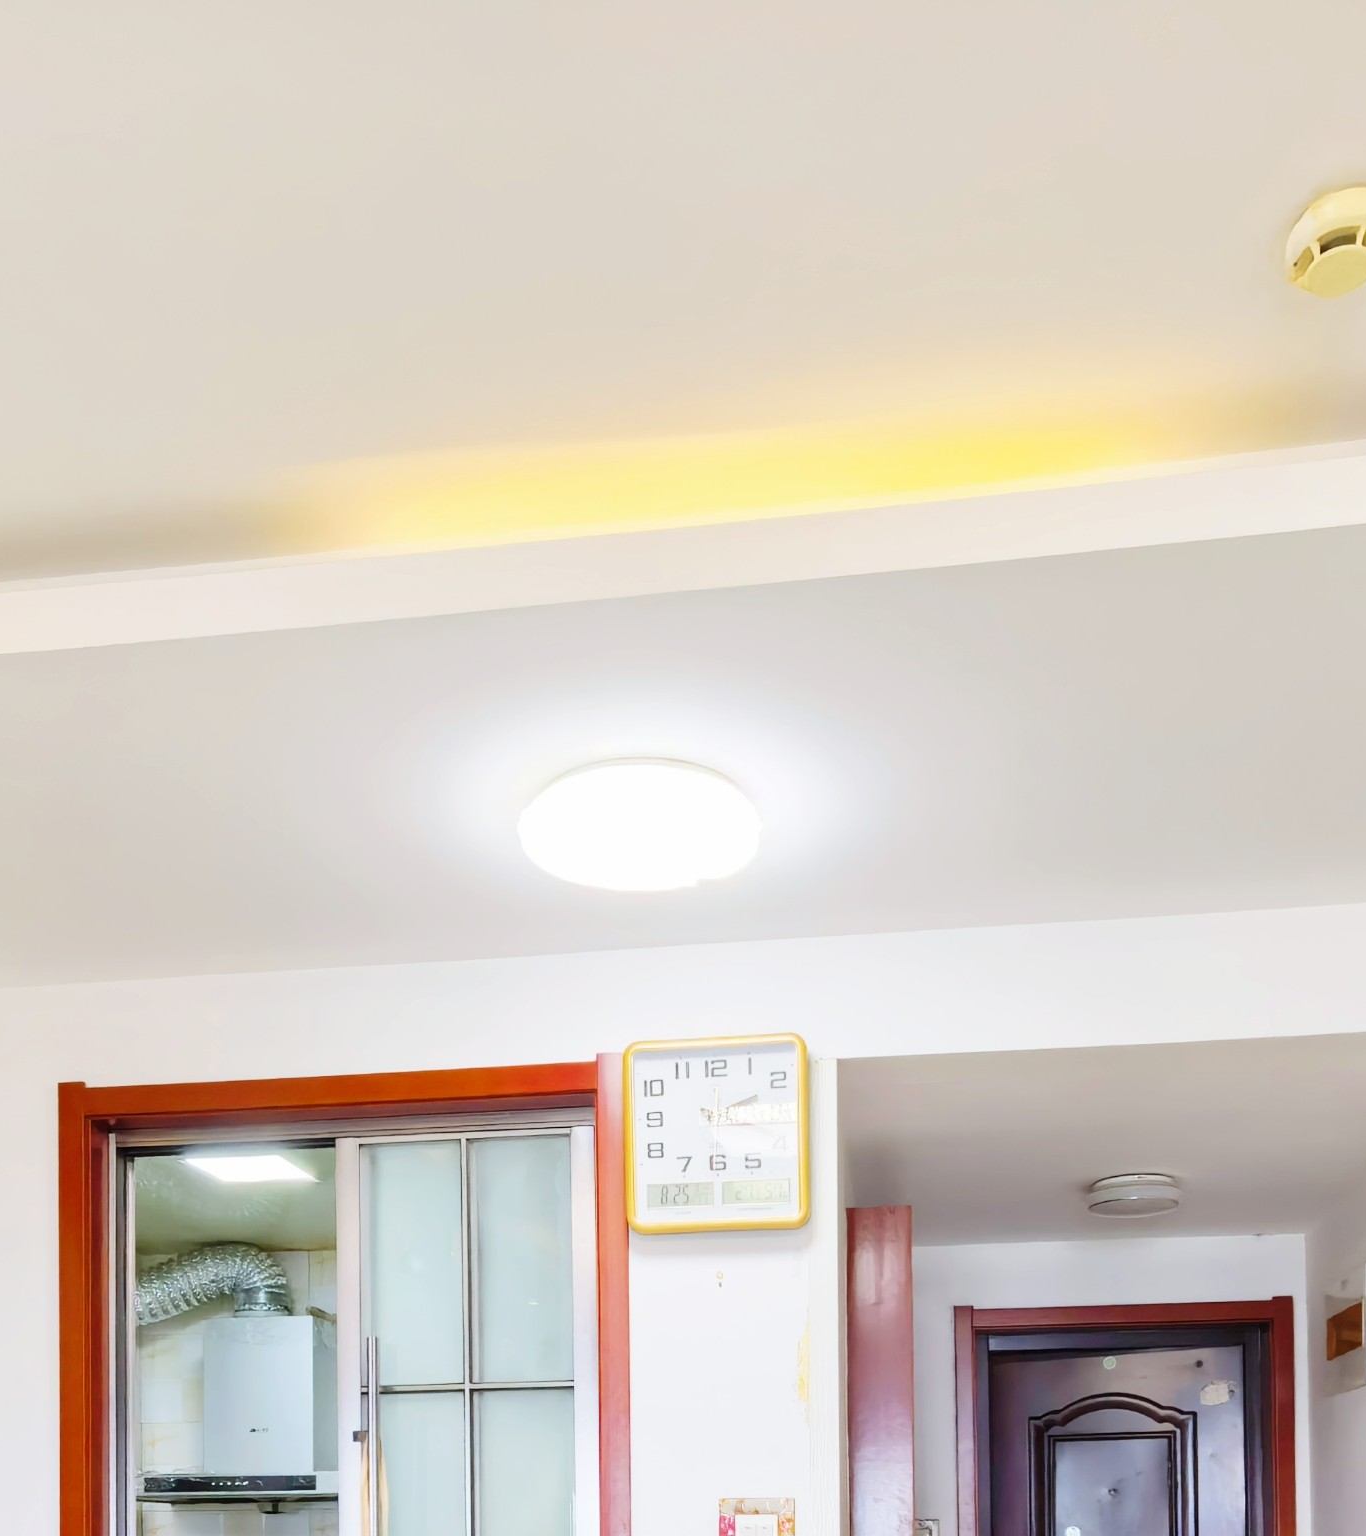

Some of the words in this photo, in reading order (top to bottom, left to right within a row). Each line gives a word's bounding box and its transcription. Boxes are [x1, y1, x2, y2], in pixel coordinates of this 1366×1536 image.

[674, 1060, 690, 1080] 11
[704, 1058, 728, 1079] 12
[643, 1079, 665, 1097] 10
[769, 1070, 787, 1089] 2
[646, 1111, 664, 1128] 9
[647, 1142, 665, 1159] 8
[676, 1156, 693, 1173] 7
[709, 1154, 727, 1171] 6
[744, 1152, 762, 1170] 5
